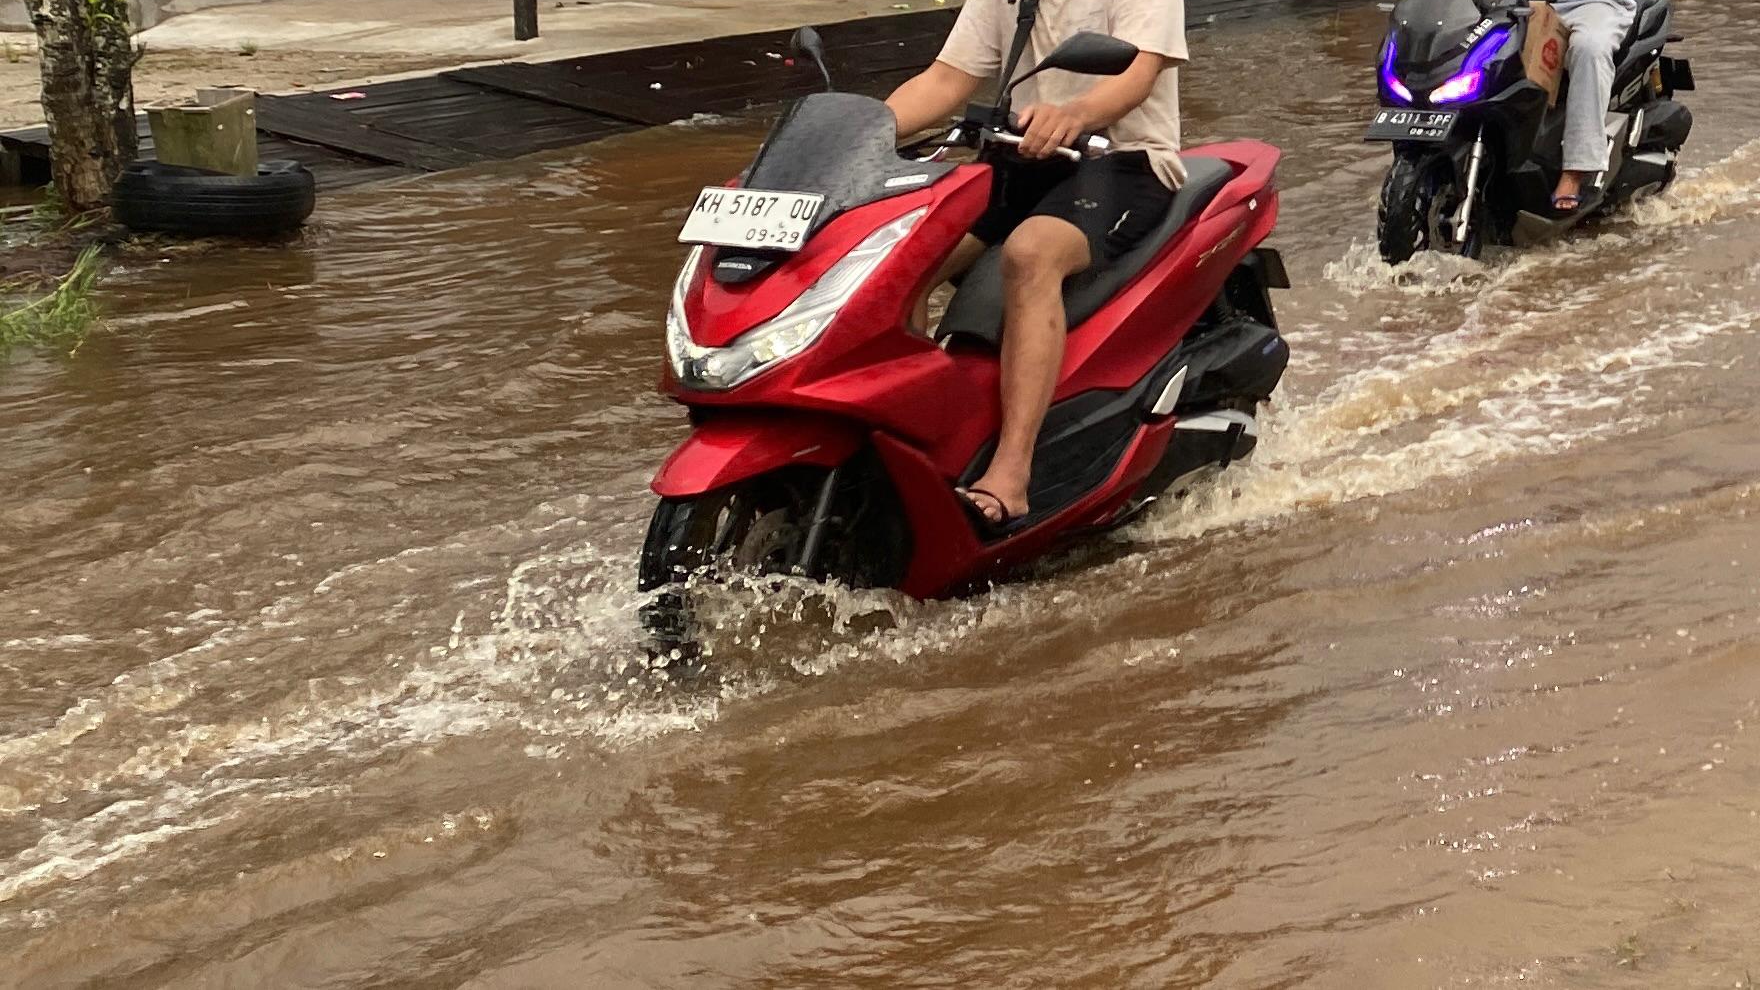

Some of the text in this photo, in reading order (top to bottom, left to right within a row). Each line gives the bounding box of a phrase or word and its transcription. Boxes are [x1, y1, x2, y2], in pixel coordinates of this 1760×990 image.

[695, 193, 817, 221] KH 5187 OU
